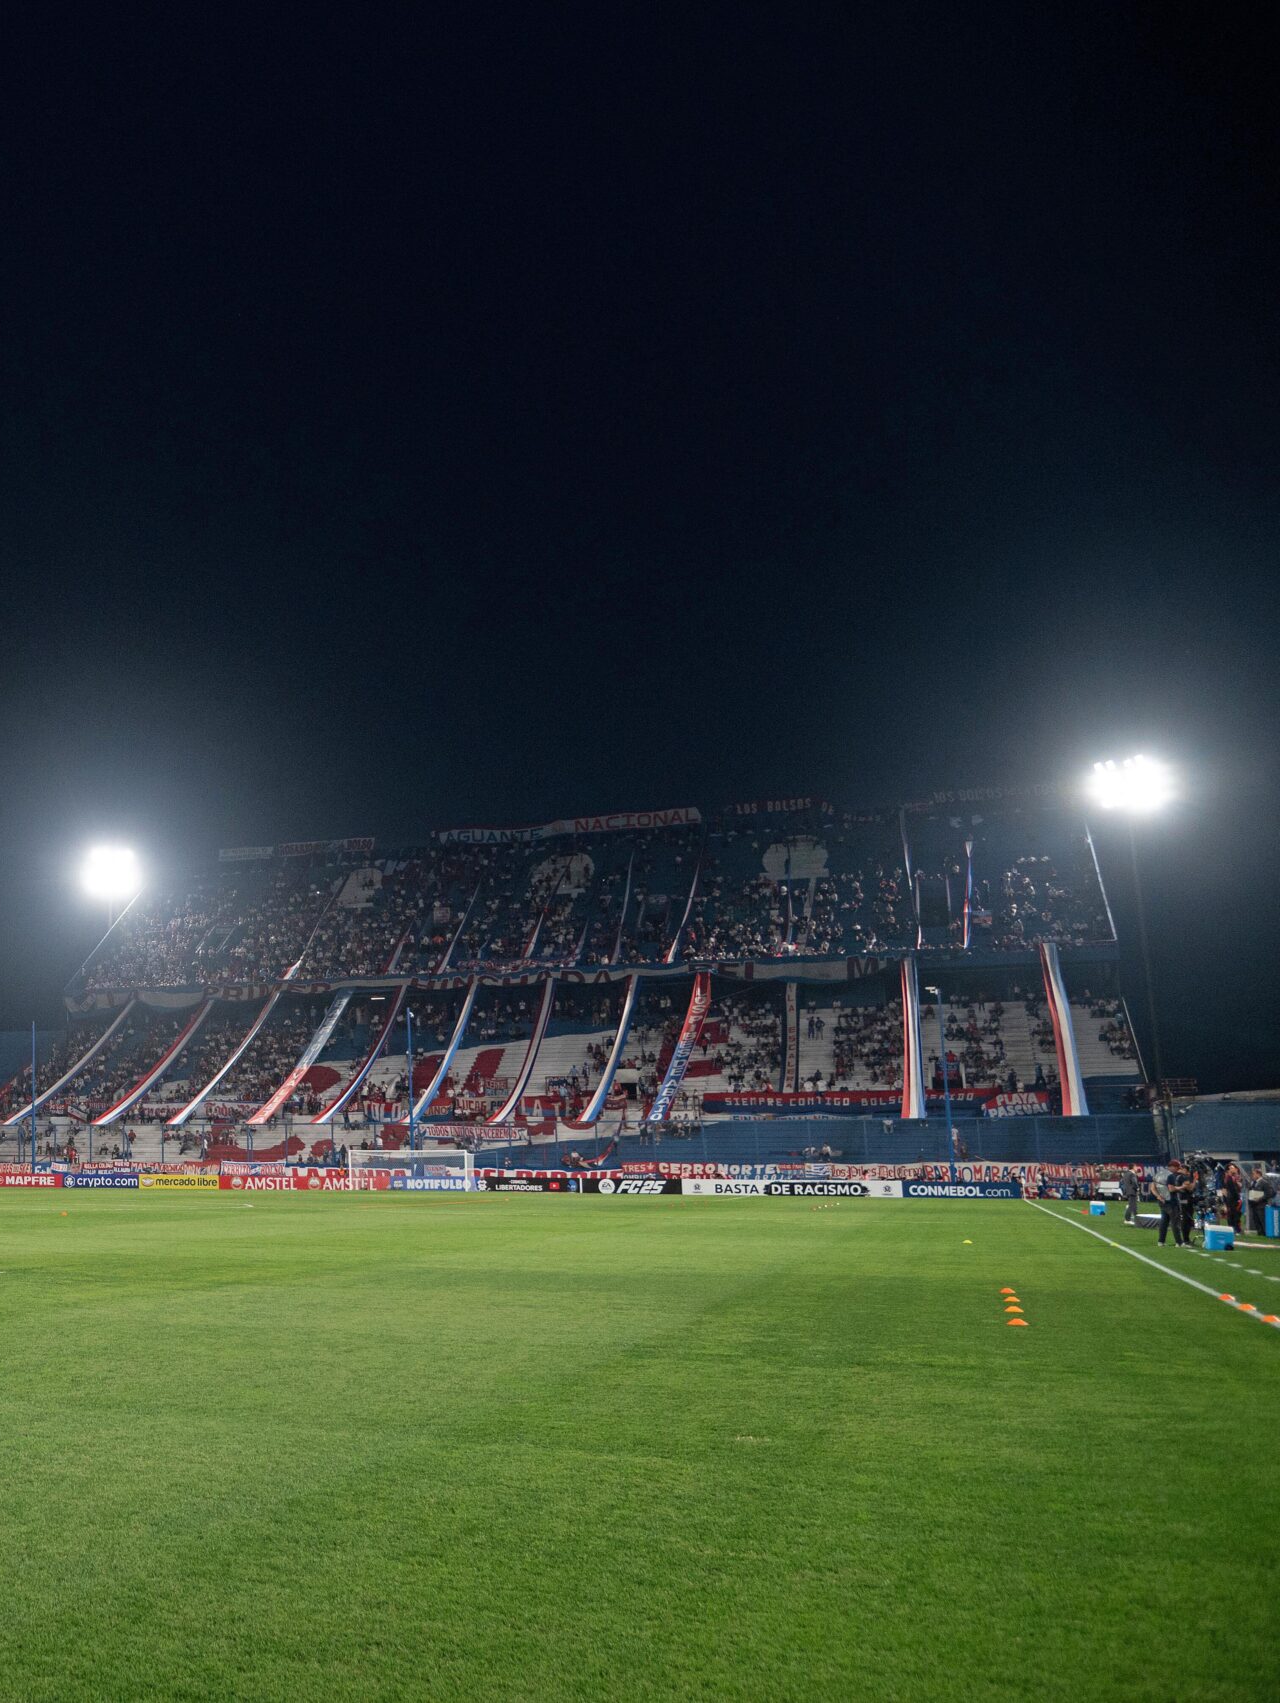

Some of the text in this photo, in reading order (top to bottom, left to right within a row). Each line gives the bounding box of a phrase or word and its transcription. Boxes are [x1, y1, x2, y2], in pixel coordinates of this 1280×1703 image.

[737, 803, 757, 815] LOS
[767, 797, 812, 813] BOLSOS
[445, 807, 698, 844] AGUANTE NACIONAL
[650, 1080, 678, 1121] ABAJO
[725, 1096, 783, 1107] SIEMPRE
[789, 1095, 850, 1107] CONTIGO
[996, 1092, 1038, 1106] PLAYA
[622, 1164, 646, 1173] TRES
[658, 1162, 717, 1175] CERRO
[5, 1176, 55, 1186] MAPFRE
[77, 1175, 138, 1188] crypto.com
[155, 1177, 217, 1187] mercado libre
[245, 1177, 297, 1190] AMSTEL
[322, 1177, 378, 1191] AMSTEL
[495, 1184, 543, 1192] LIBERTADORES
[715, 1184, 861, 1196] BASTA DE RACISMO
